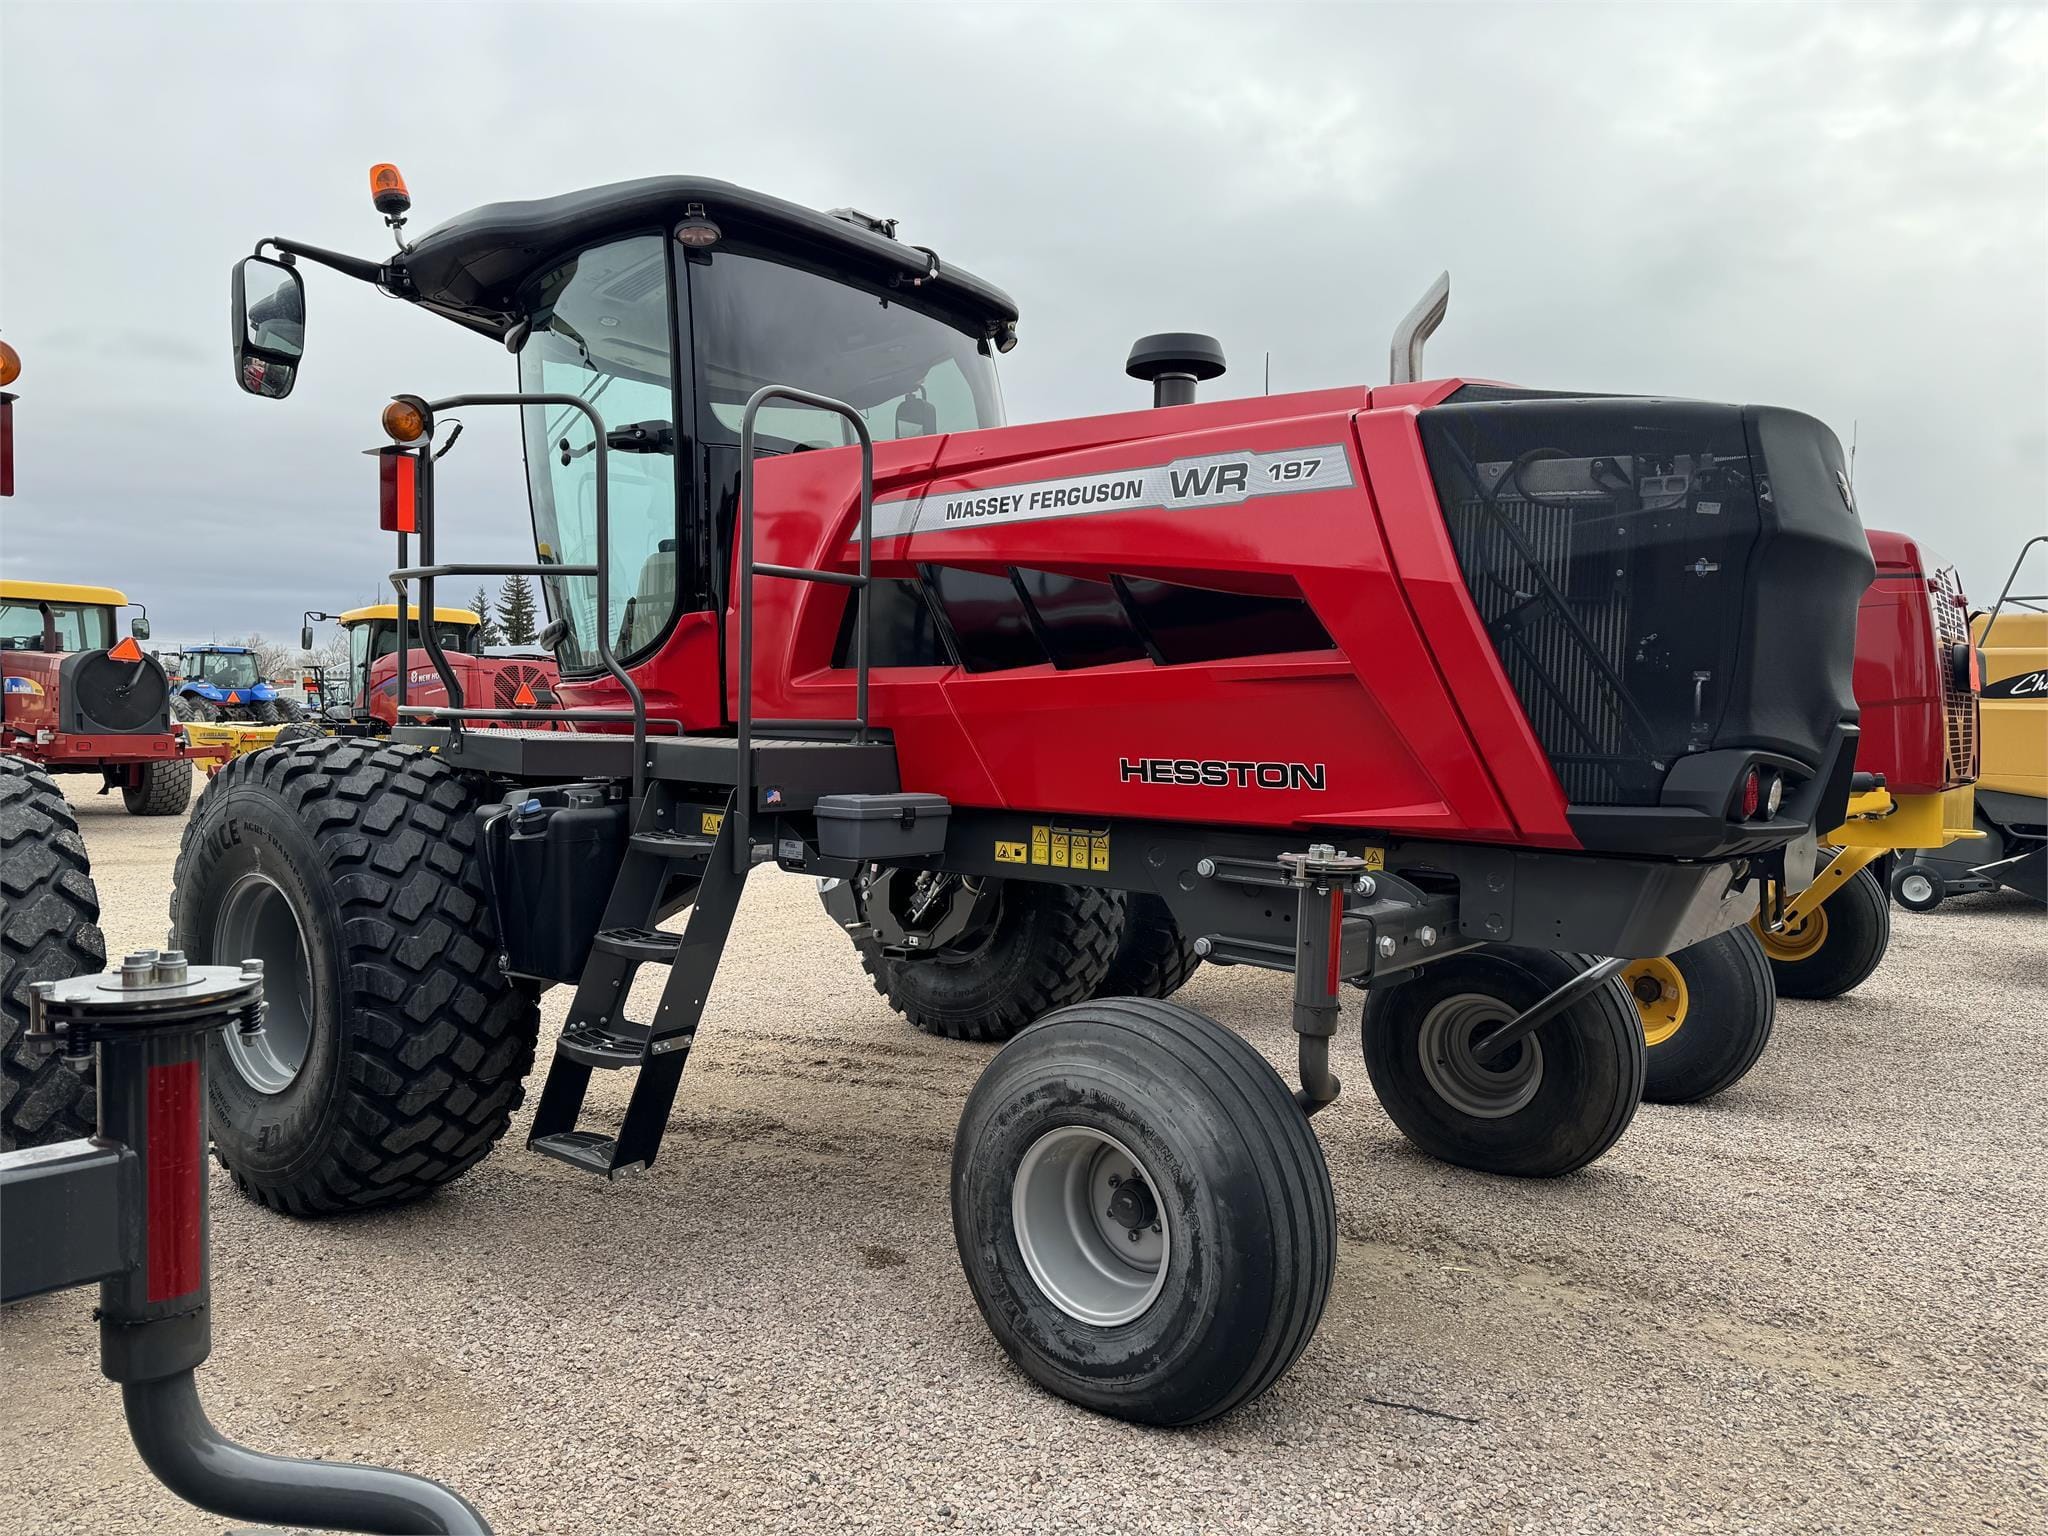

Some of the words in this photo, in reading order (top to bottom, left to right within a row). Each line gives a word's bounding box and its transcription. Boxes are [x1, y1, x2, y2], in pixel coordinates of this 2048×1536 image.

[1169, 462, 1249, 499] WR
[1268, 458, 1322, 482] 197
[945, 494, 1024, 521] MASSEY
[1029, 479, 1144, 511] FERGUSON
[1119, 757, 1326, 791] HESSTON
